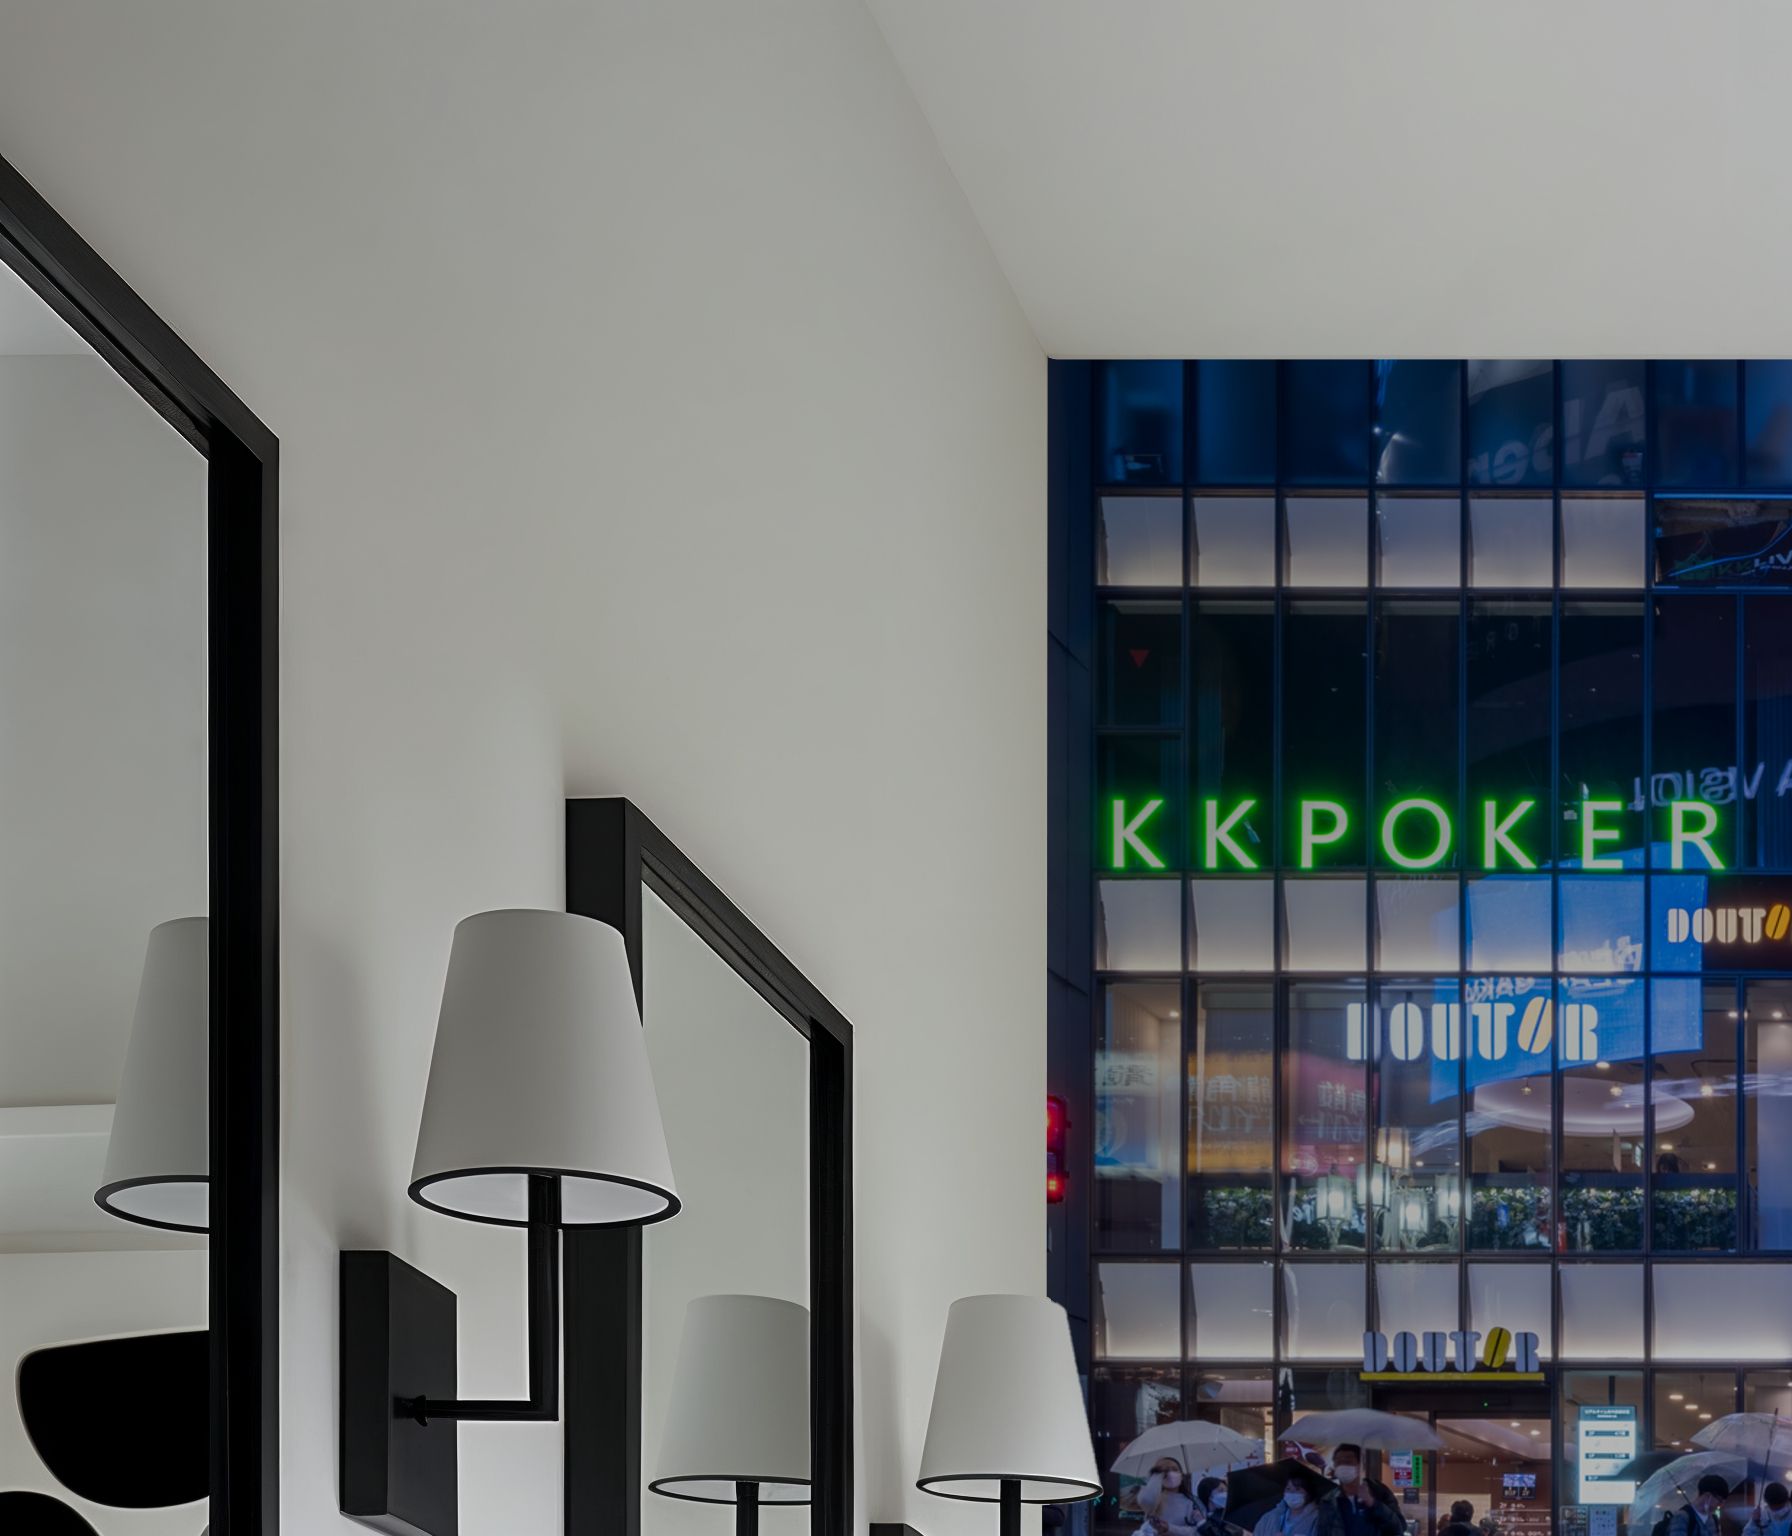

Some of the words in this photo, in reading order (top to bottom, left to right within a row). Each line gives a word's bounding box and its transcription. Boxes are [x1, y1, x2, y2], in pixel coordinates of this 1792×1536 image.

[1112, 798, 1726, 870] KKPOKER
[1347, 997, 1599, 1061] DOUTOR
[1363, 1326, 1540, 1372] DOUTOR
